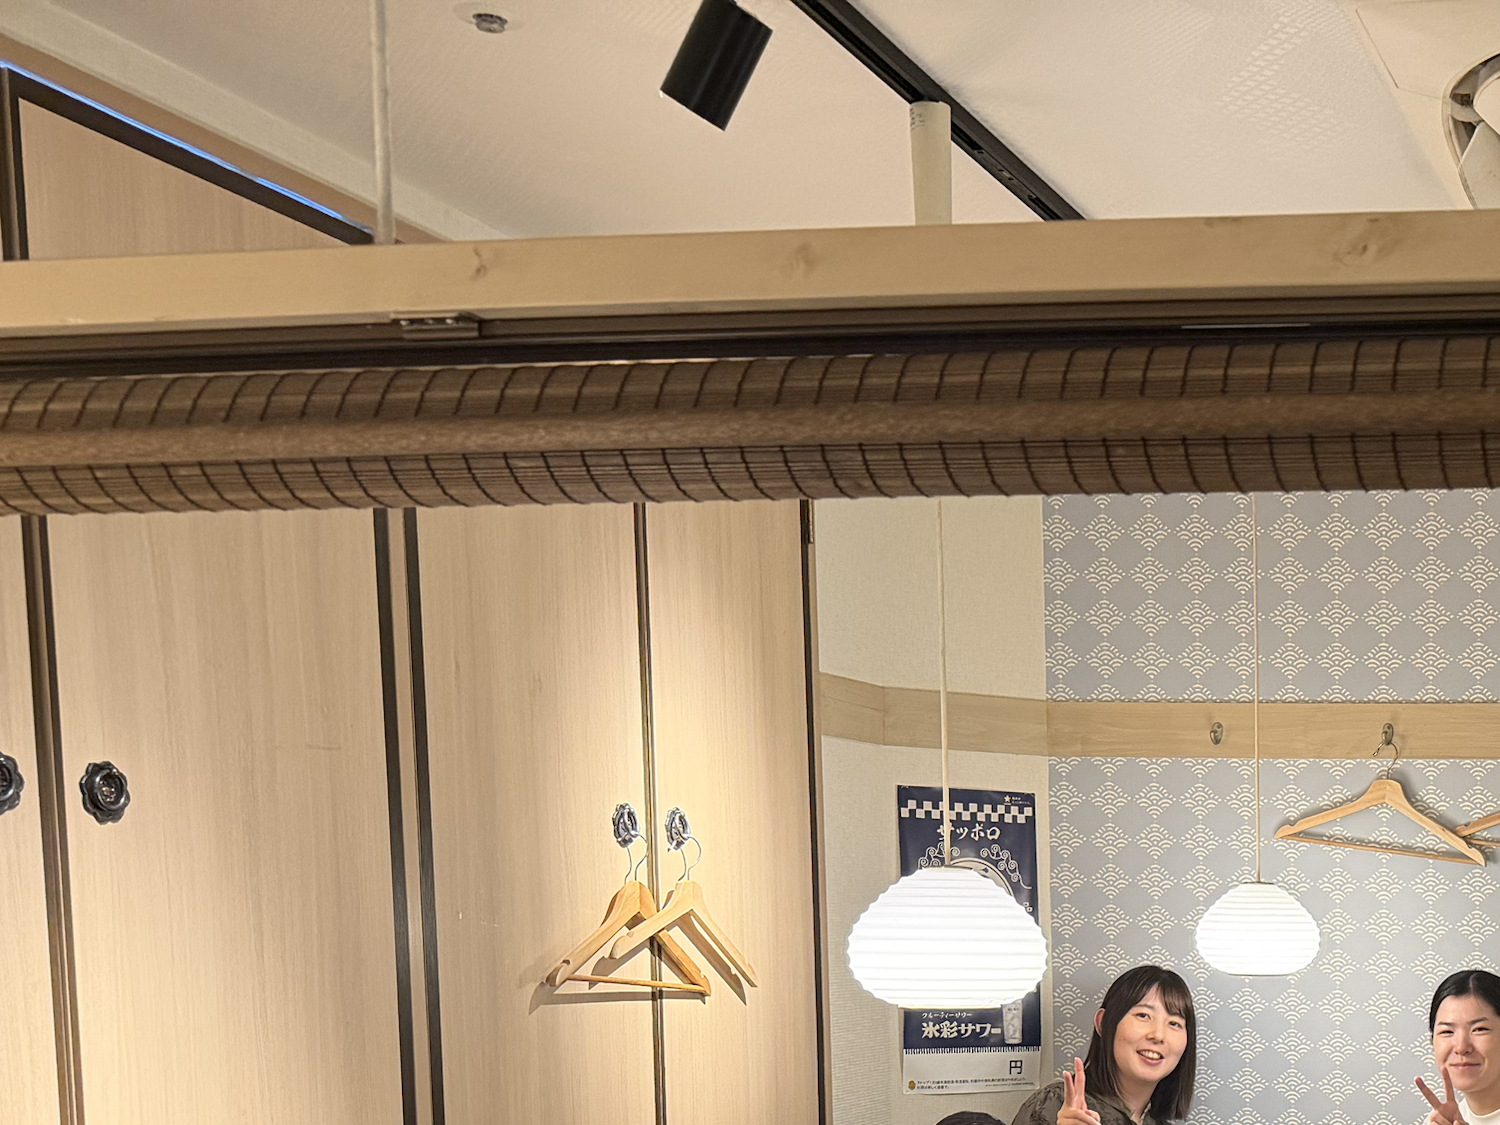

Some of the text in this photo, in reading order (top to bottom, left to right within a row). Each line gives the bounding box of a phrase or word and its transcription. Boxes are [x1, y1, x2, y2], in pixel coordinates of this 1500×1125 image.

[921, 1020, 1002, 1038] 氷彩サワー
[1009, 1060, 1023, 1075] 円
